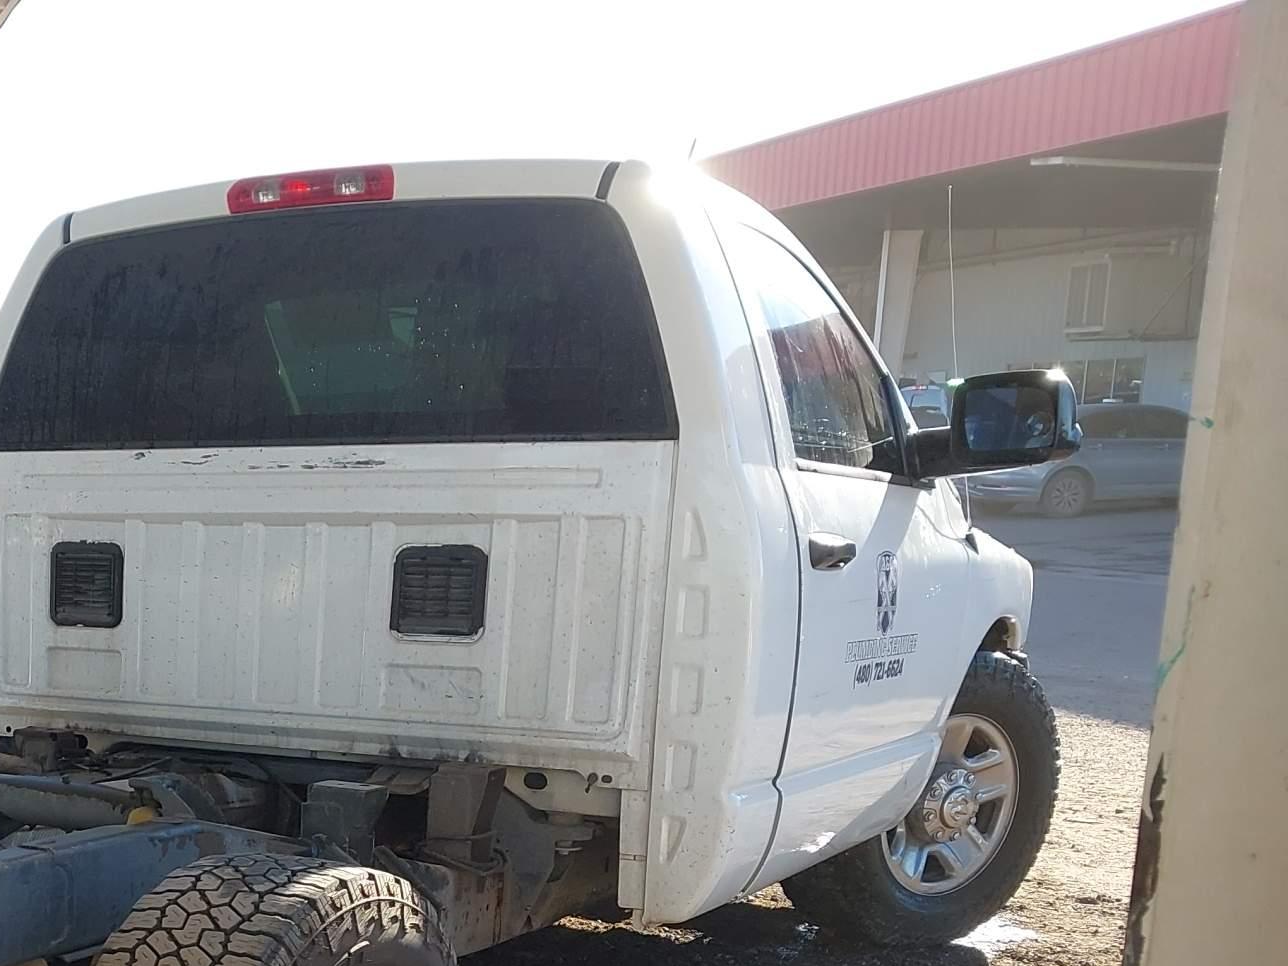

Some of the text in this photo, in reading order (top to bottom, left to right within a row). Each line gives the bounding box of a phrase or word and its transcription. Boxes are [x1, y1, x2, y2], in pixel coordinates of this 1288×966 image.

[886, 633, 918, 656] SERVICE
[853, 658, 905, 689] (480) 721-6624
